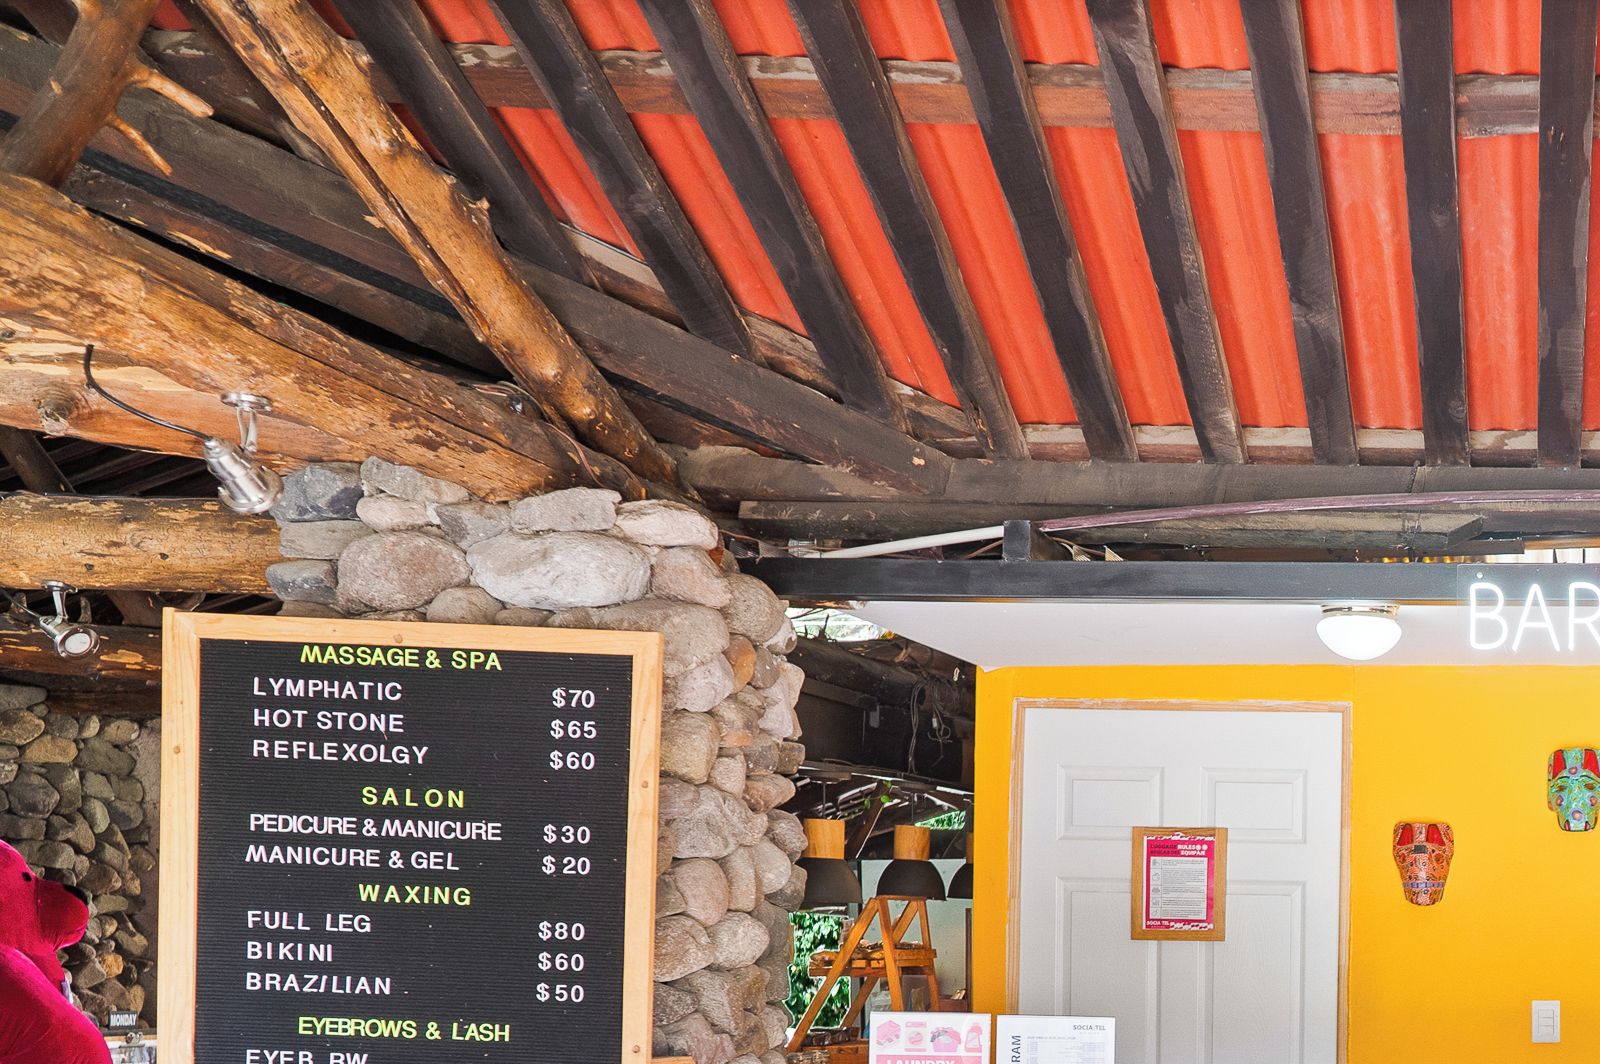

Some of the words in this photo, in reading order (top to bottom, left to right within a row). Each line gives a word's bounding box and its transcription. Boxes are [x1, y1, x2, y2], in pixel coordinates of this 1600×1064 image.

[300, 644, 420, 668] MASSAGE
[425, 649, 442, 669] &
[451, 650, 503, 671] SPA
[253, 676, 402, 701] LYMPHATIC
[552, 687, 596, 709] $70
[253, 708, 309, 728] HOT
[316, 710, 404, 731] STONE
[549, 718, 597, 740] $65
[252, 739, 429, 765] REFLEXOLGY
[549, 749, 595, 771] $60
[361, 786, 464, 809] SALON
[249, 813, 358, 836] PEDICURE
[361, 818, 379, 837] &
[380, 818, 502, 841] MANICURE
[543, 823, 591, 844] $30
[244, 844, 381, 868] MANICURE
[388, 850, 405, 869] &
[410, 850, 460, 871] GEL
[358, 883, 471, 906] WAXING
[247, 910, 311, 931] FULL
[325, 913, 371, 933] LEG
[537, 920, 585, 941] $80
[246, 940, 333, 962] BIKINI
[537, 951, 585, 972] $60
[245, 971, 391, 995] BRAZILIAN
[535, 982, 585, 1003] $50
[298, 1016, 418, 1039] EYEBROWS
[425, 1021, 442, 1040] &
[451, 1022, 510, 1042] LASH
